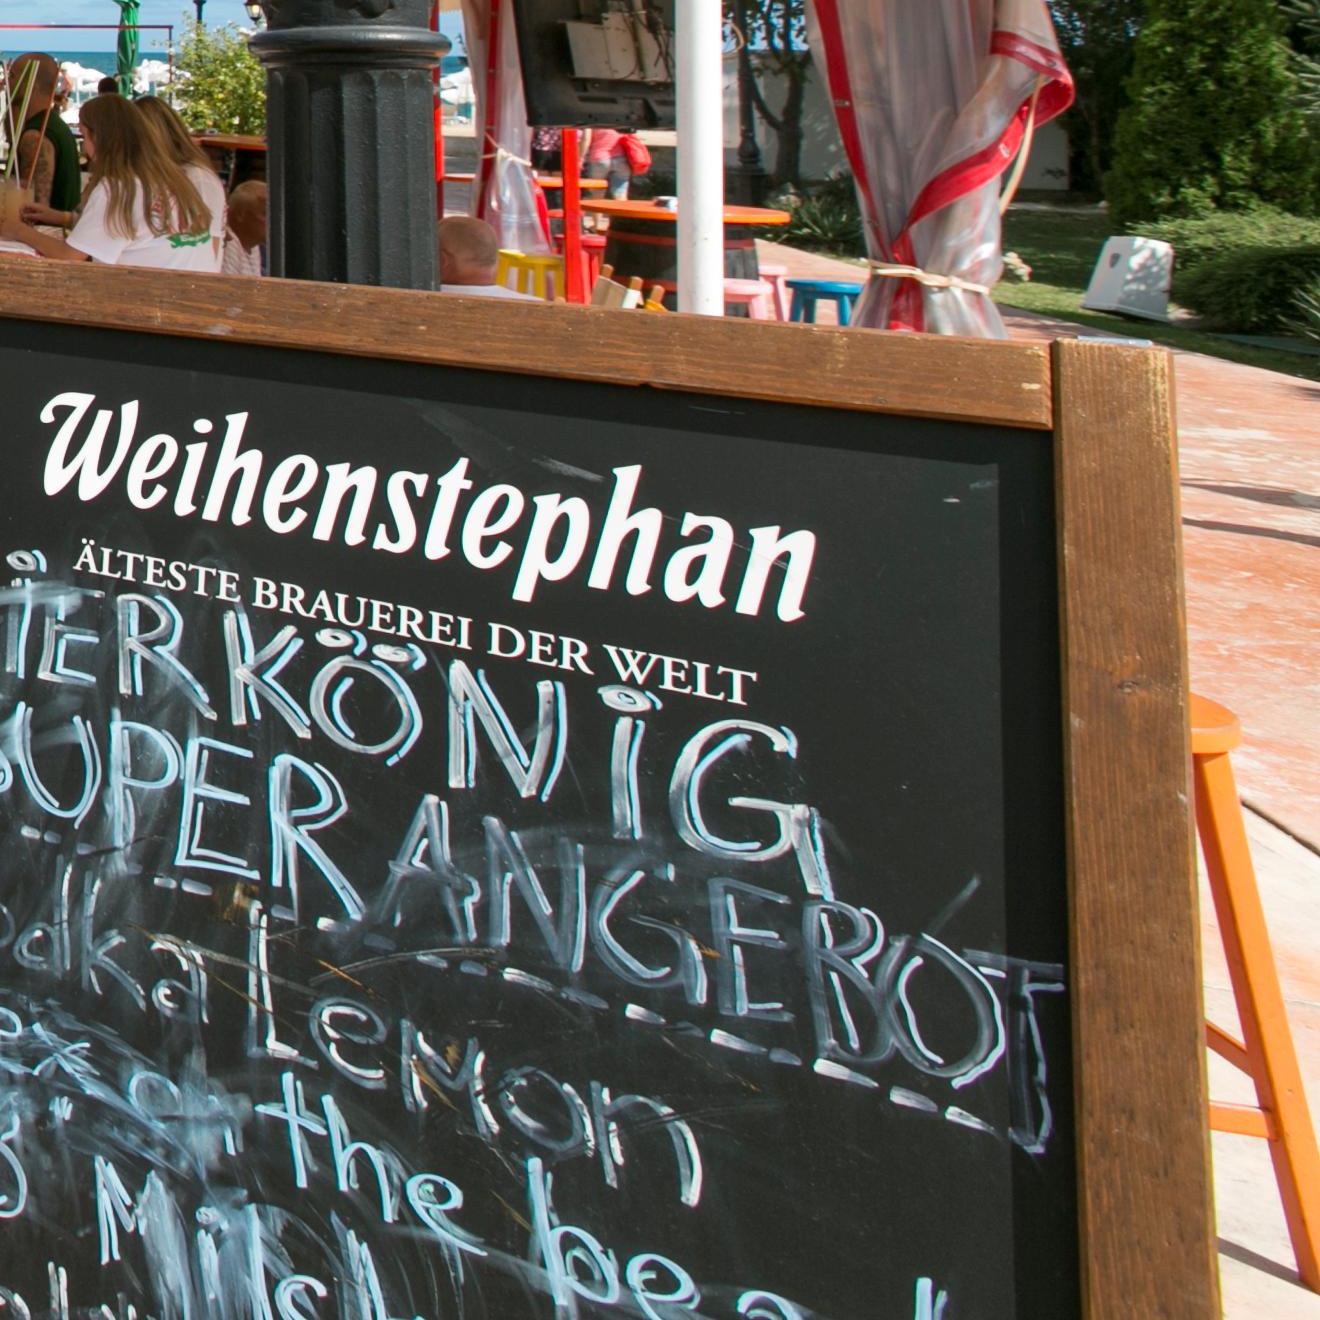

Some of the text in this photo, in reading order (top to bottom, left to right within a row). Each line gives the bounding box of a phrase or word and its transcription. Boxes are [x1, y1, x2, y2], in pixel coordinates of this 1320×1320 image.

[39, 391, 819, 623] Weihenstephan
[72, 538, 759, 706] ÄLTESTE BRAUEREI DER WELT
[255, 1071, 488, 1256] the
